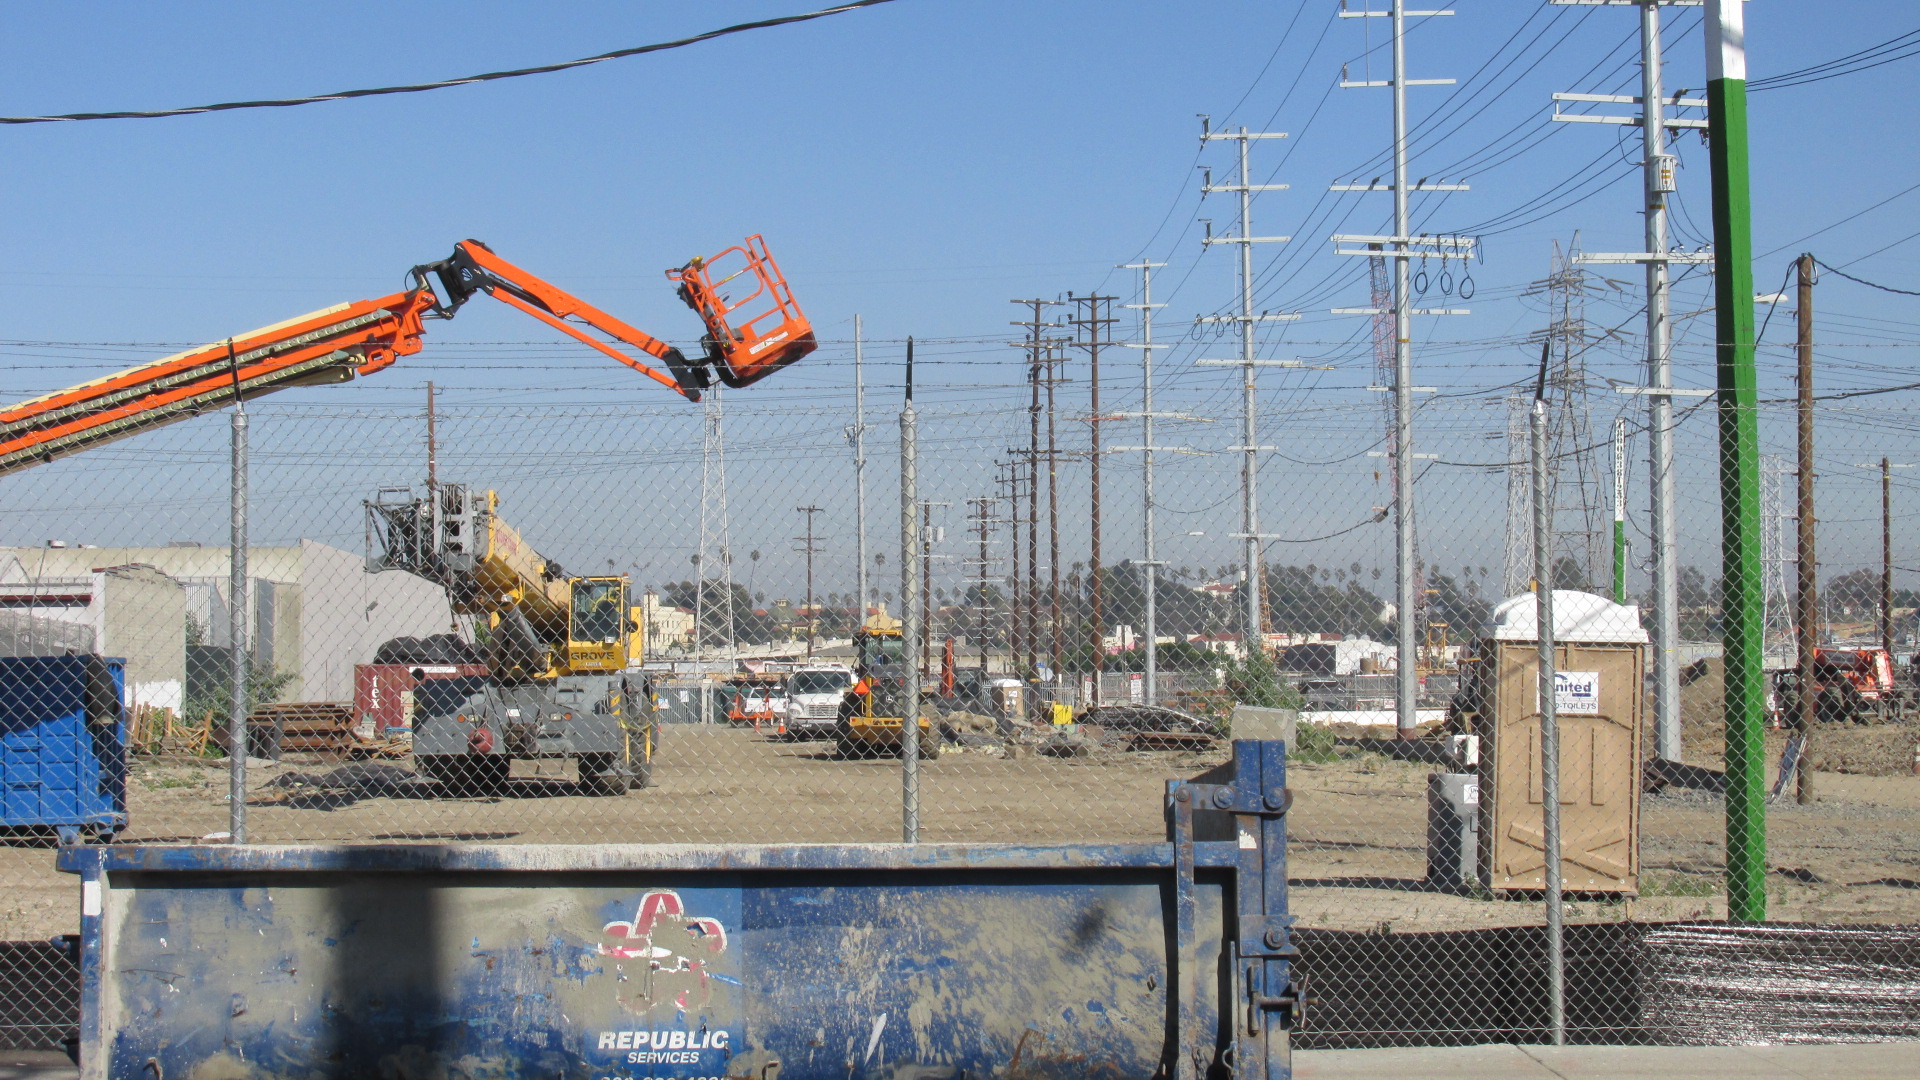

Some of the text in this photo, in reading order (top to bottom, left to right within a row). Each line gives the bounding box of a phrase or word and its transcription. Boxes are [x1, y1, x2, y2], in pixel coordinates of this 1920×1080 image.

[571, 651, 614, 660] GROVE
[1556, 681, 1592, 692] nited
[598, 1030, 729, 1050] REPUBLIC
[628, 1051, 700, 1064] SERVICES
